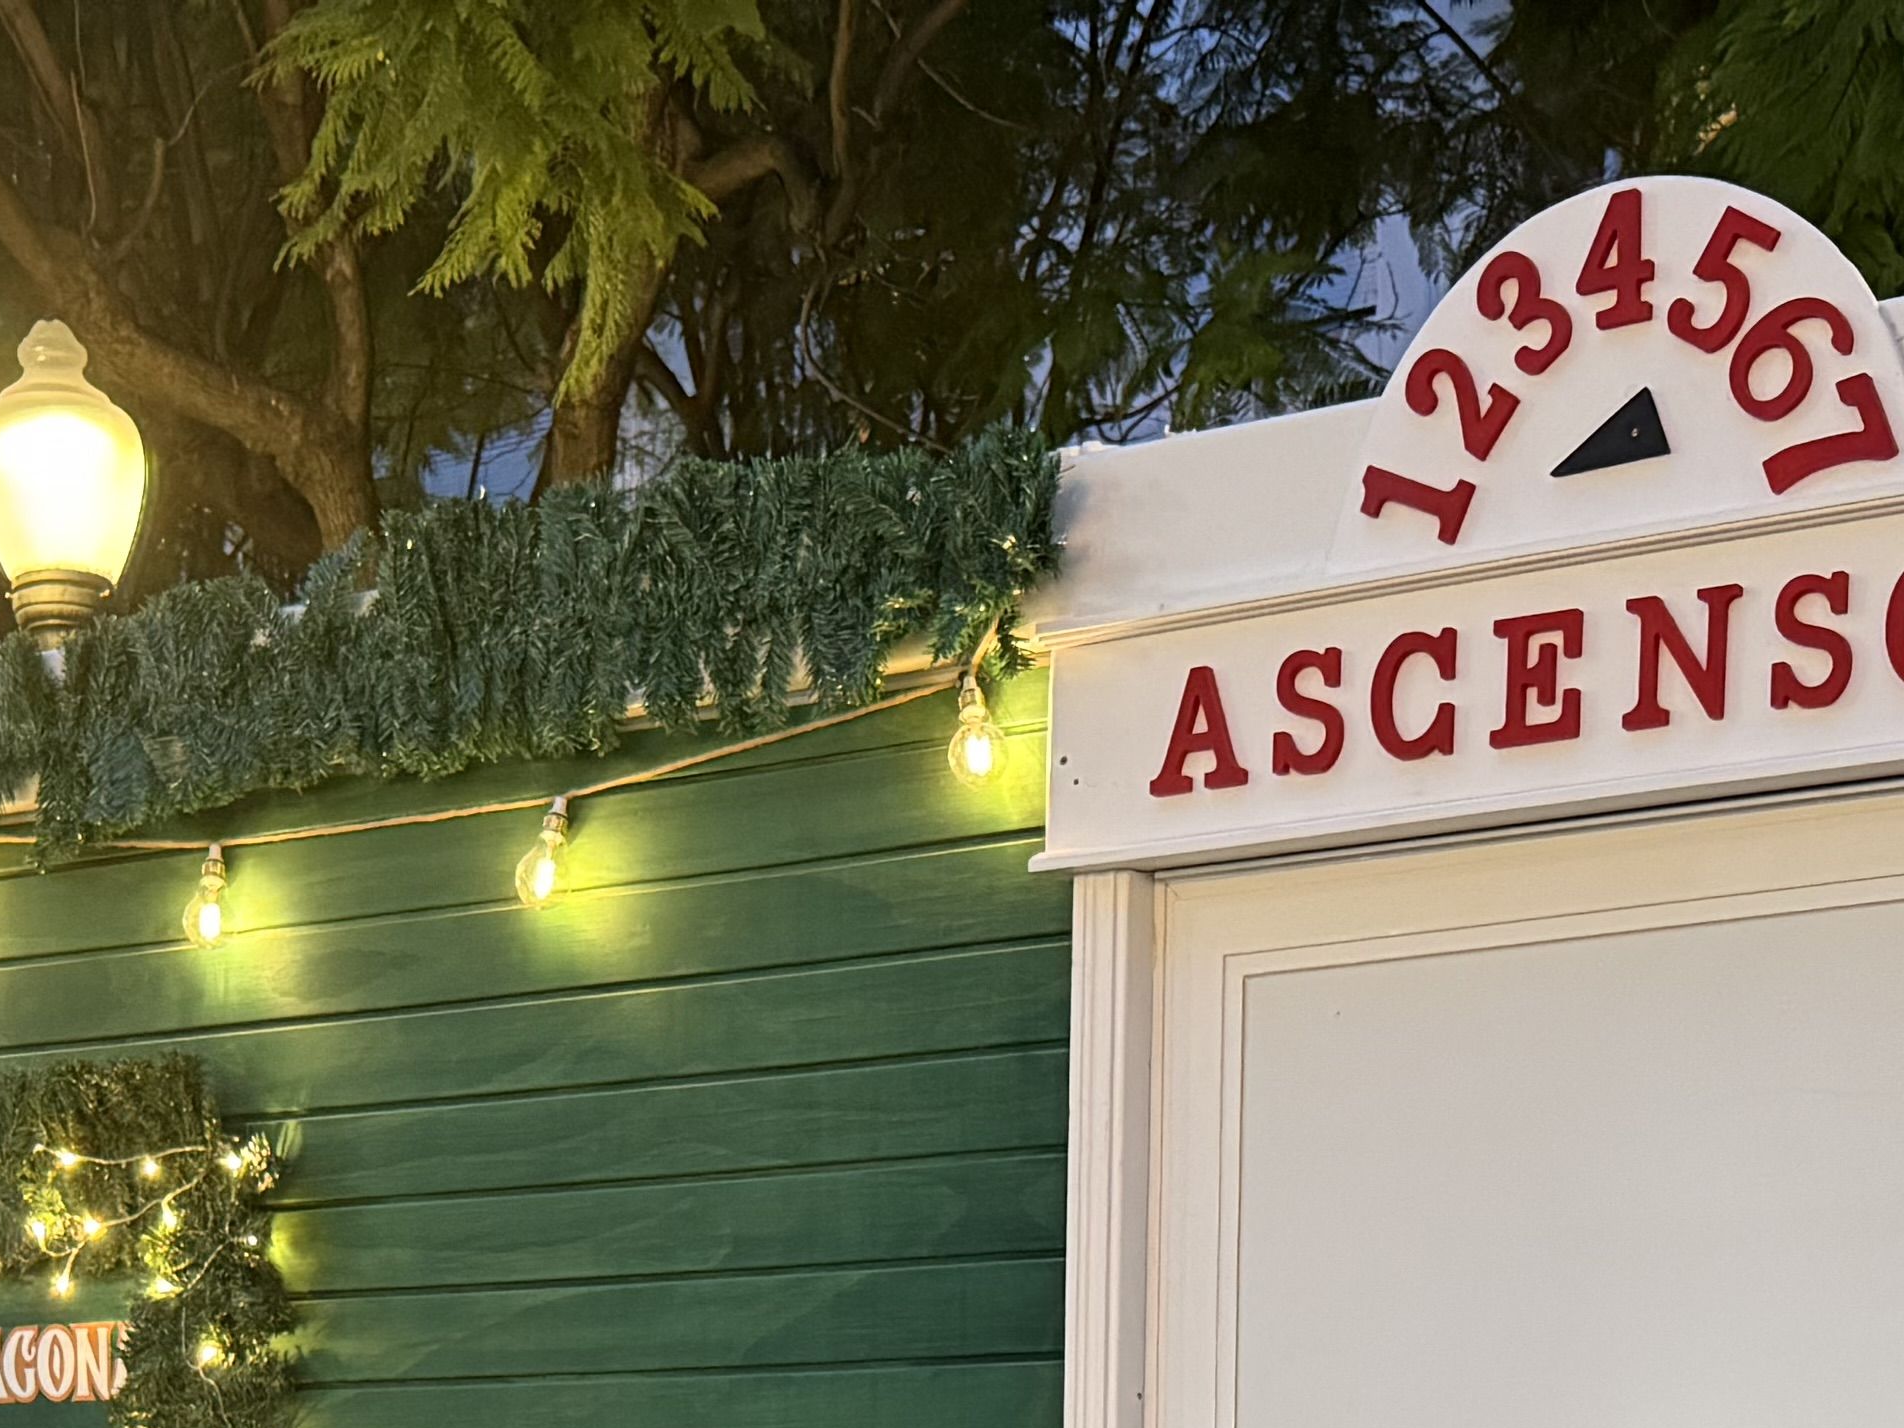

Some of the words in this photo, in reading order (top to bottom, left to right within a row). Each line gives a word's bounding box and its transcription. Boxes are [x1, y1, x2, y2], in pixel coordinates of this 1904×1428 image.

[1477, 250, 1573, 375] 3
[1576, 188, 1658, 331] 4
[1667, 206, 1782, 353] 5
[1406, 349, 1520, 461] 2
[1729, 297, 1855, 422] 6
[1763, 372, 1898, 495] 7
[1362, 466, 1476, 545] 1
